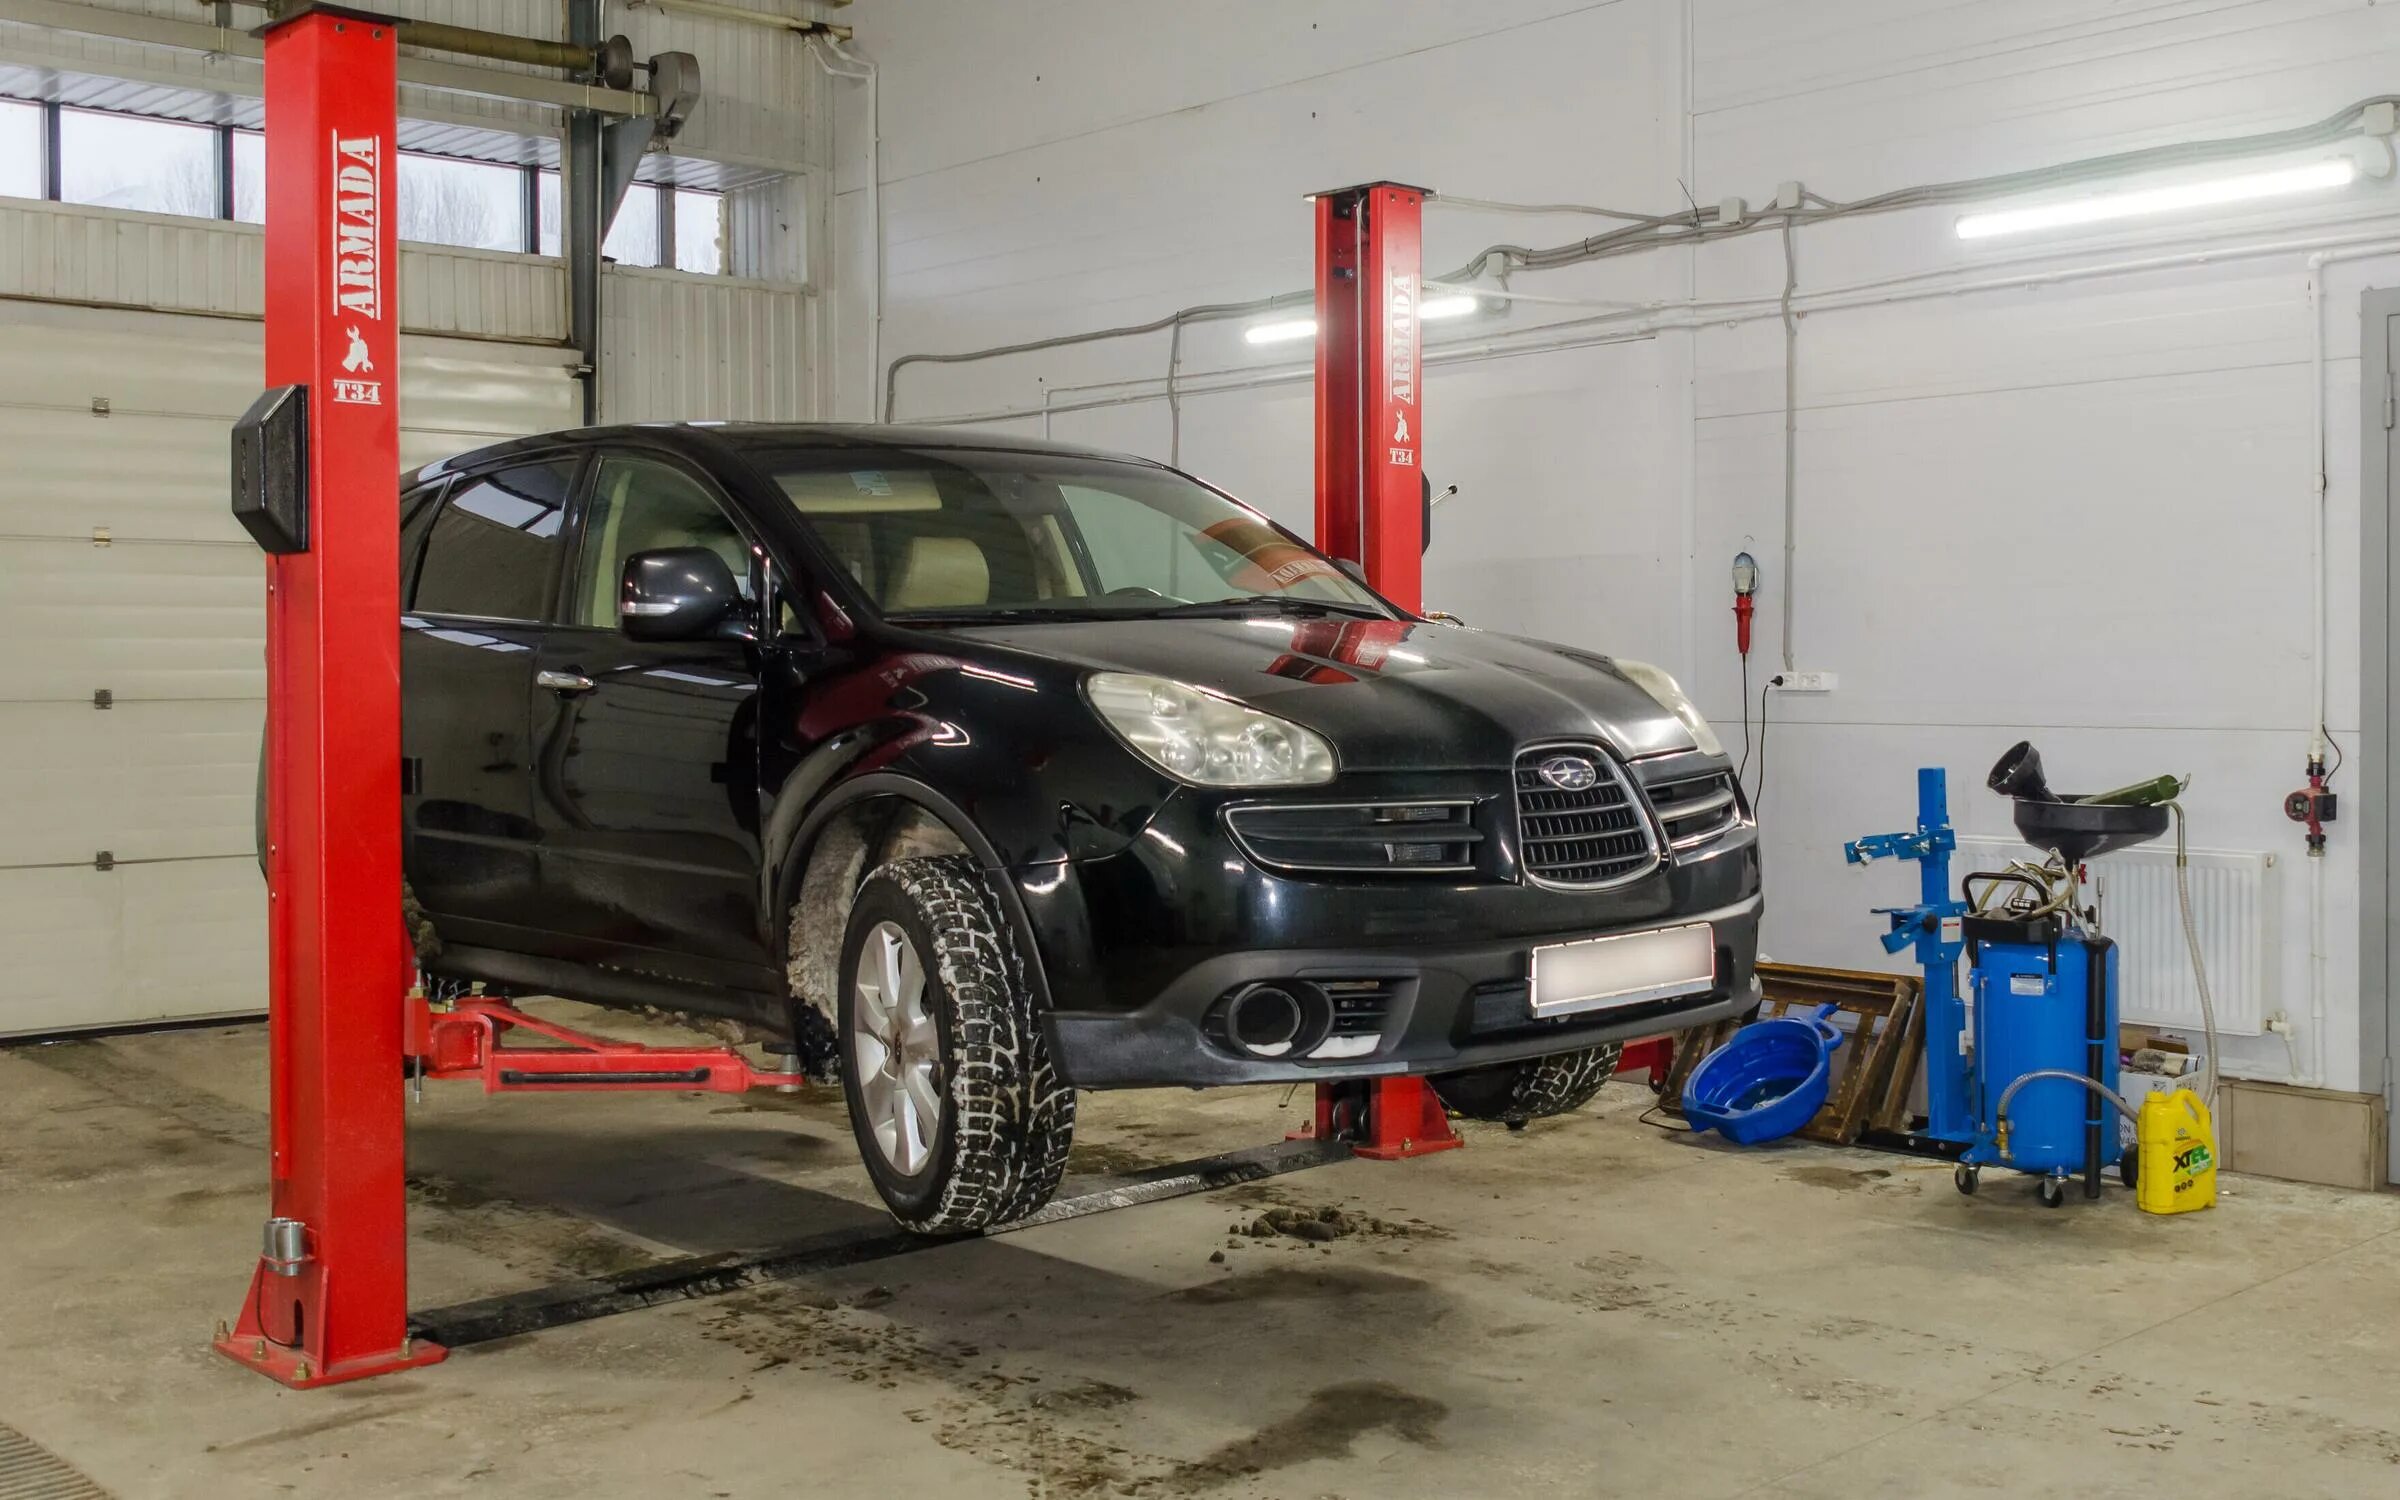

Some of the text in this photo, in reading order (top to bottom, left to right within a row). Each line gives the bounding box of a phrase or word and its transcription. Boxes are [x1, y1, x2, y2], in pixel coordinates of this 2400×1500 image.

[339, 137, 375, 320] ARMADA
[1392, 274, 1411, 404] ARMADA
[334, 382, 380, 402] T34
[1389, 450, 1413, 464] T34
